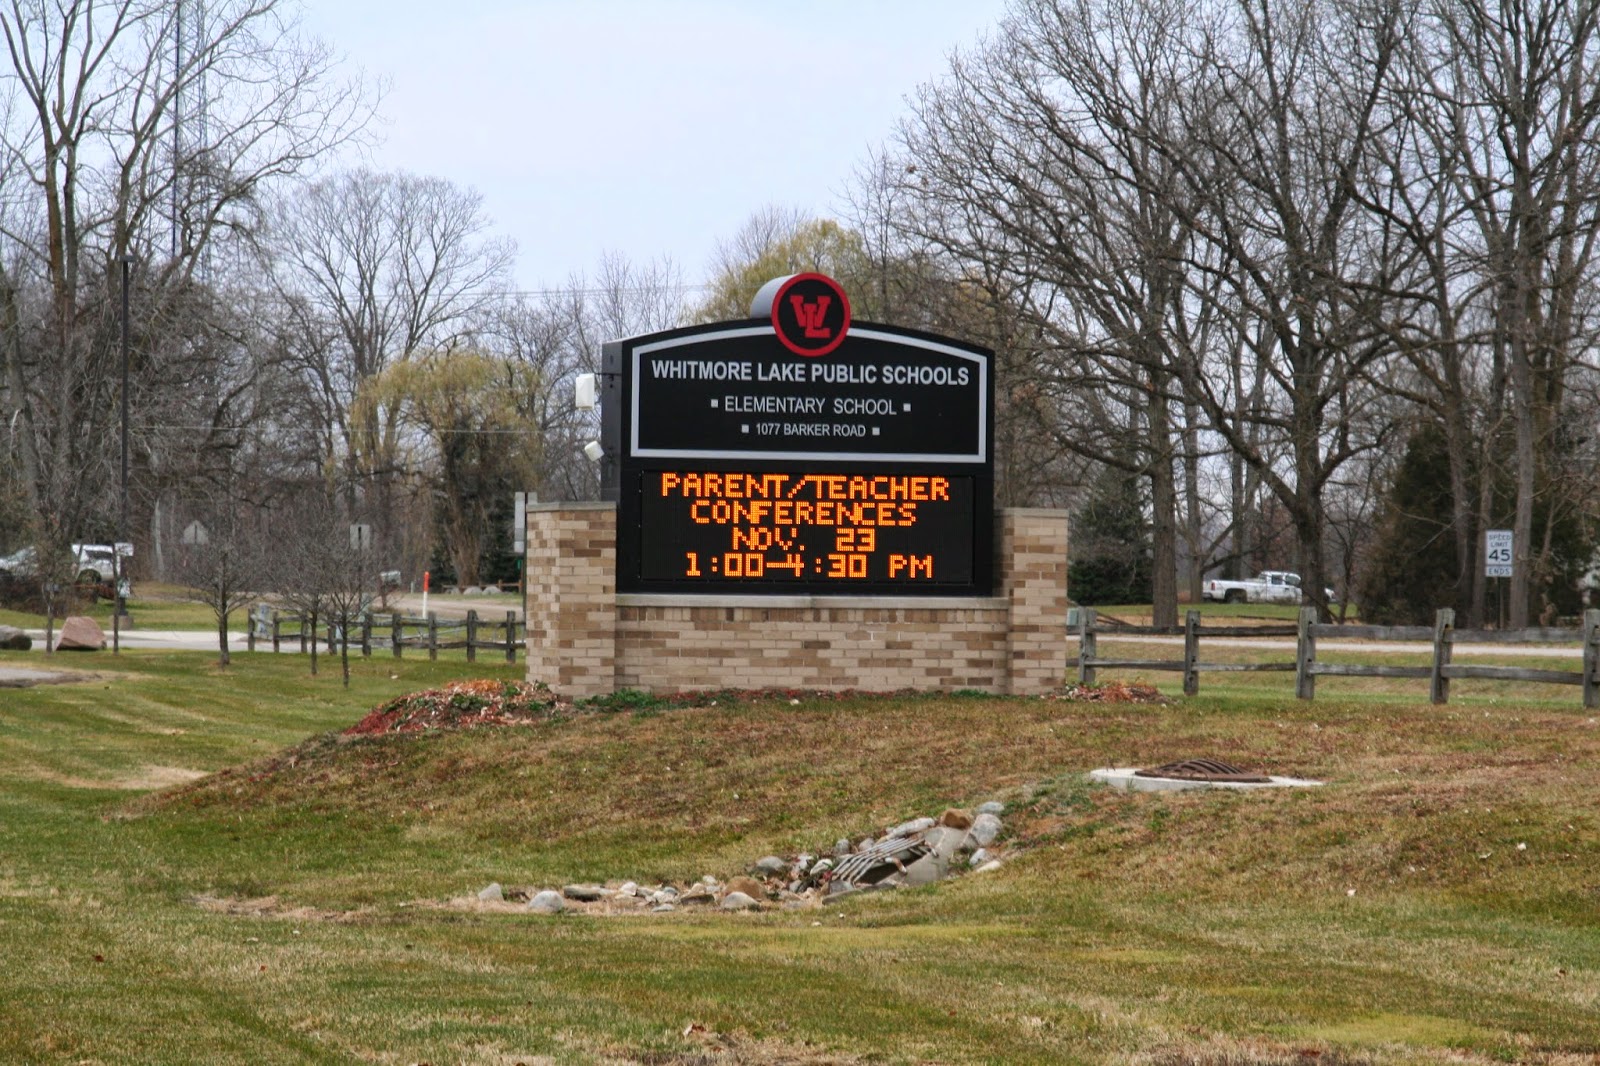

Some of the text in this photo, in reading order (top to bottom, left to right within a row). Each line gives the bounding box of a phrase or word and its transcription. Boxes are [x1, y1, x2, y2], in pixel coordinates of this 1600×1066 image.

[651, 359, 970, 386] WHITMORE LAKE PUBLIC SCHOOLS
[724, 396, 897, 415] ELEMENTARY SCHOOL
[755, 423, 866, 437] 1077 BARKER ROAD
[661, 472, 949, 501] PARENT/TEACHER
[690, 500, 917, 527] CONFERENCES
[732, 527, 875, 552] NOV. 23
[889, 554, 932, 579] PM
[1488, 549, 1511, 562] 45
